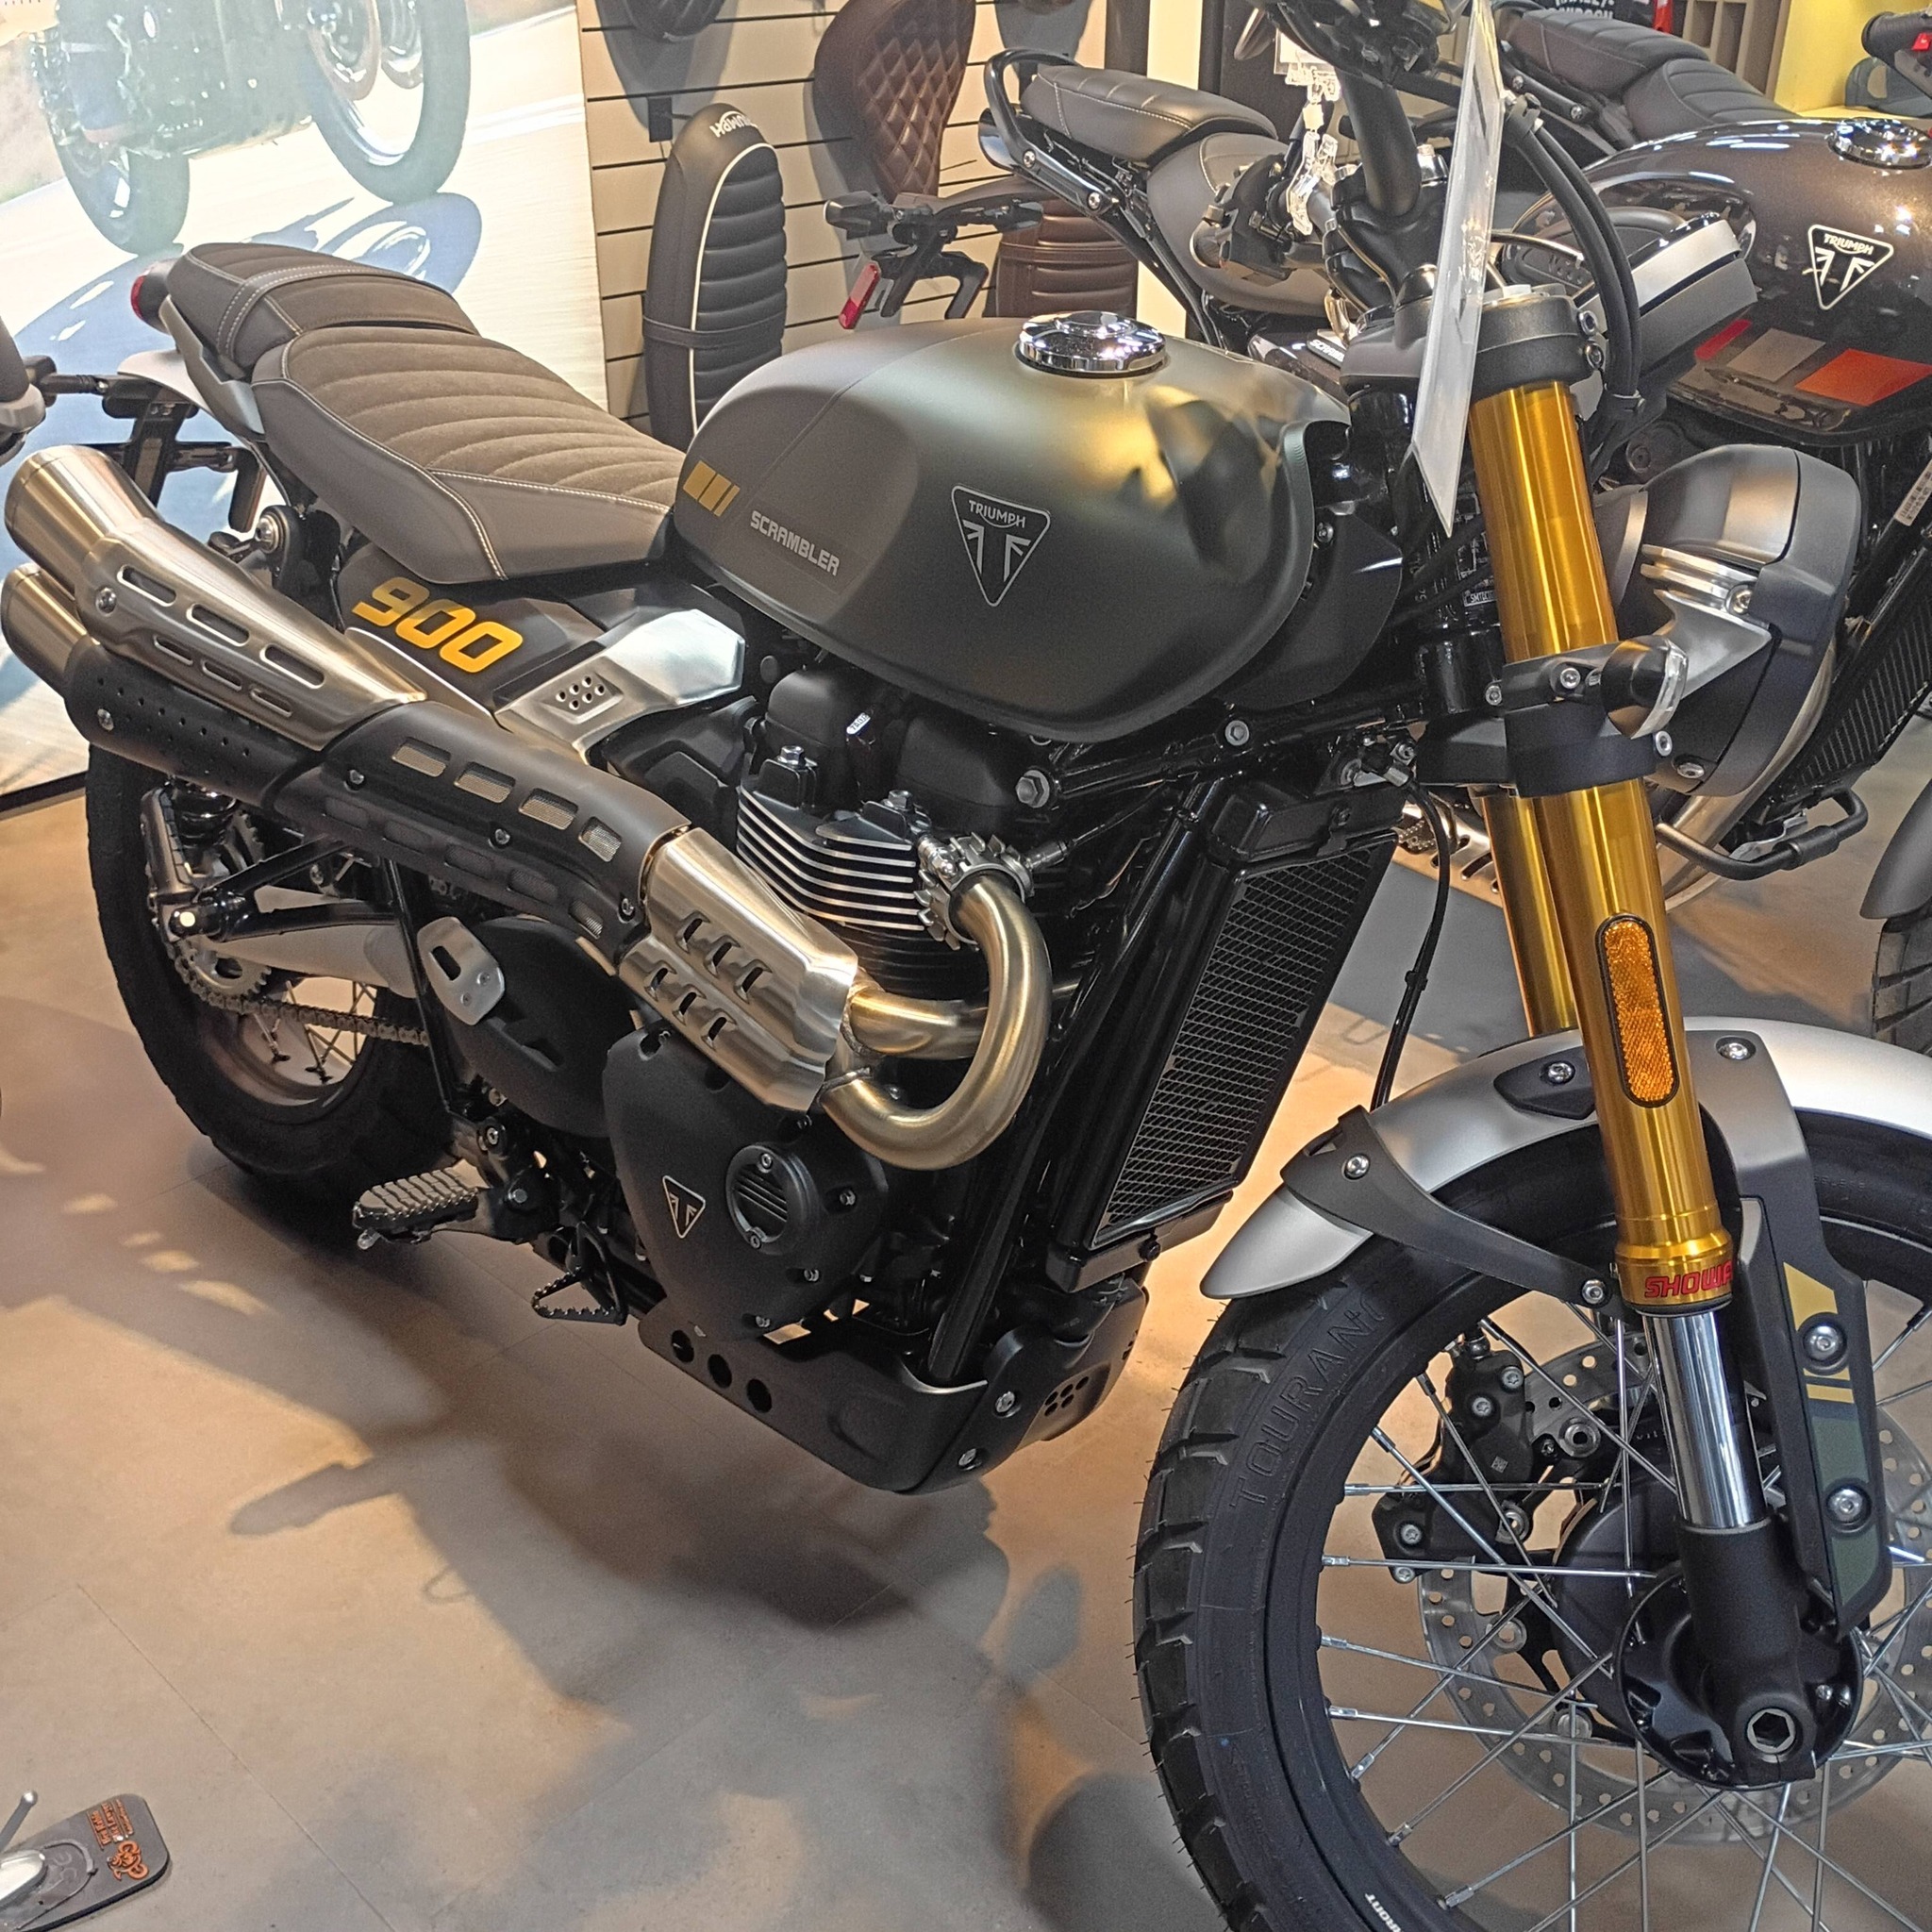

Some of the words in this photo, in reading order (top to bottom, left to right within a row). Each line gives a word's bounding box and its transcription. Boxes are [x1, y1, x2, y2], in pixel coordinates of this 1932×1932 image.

[1824, 233, 1874, 256] TRIUMPH
[969, 499, 1025, 528] TRIUMPH
[750, 510, 840, 576] SCRAMBLER
[352, 576, 524, 673] 900
